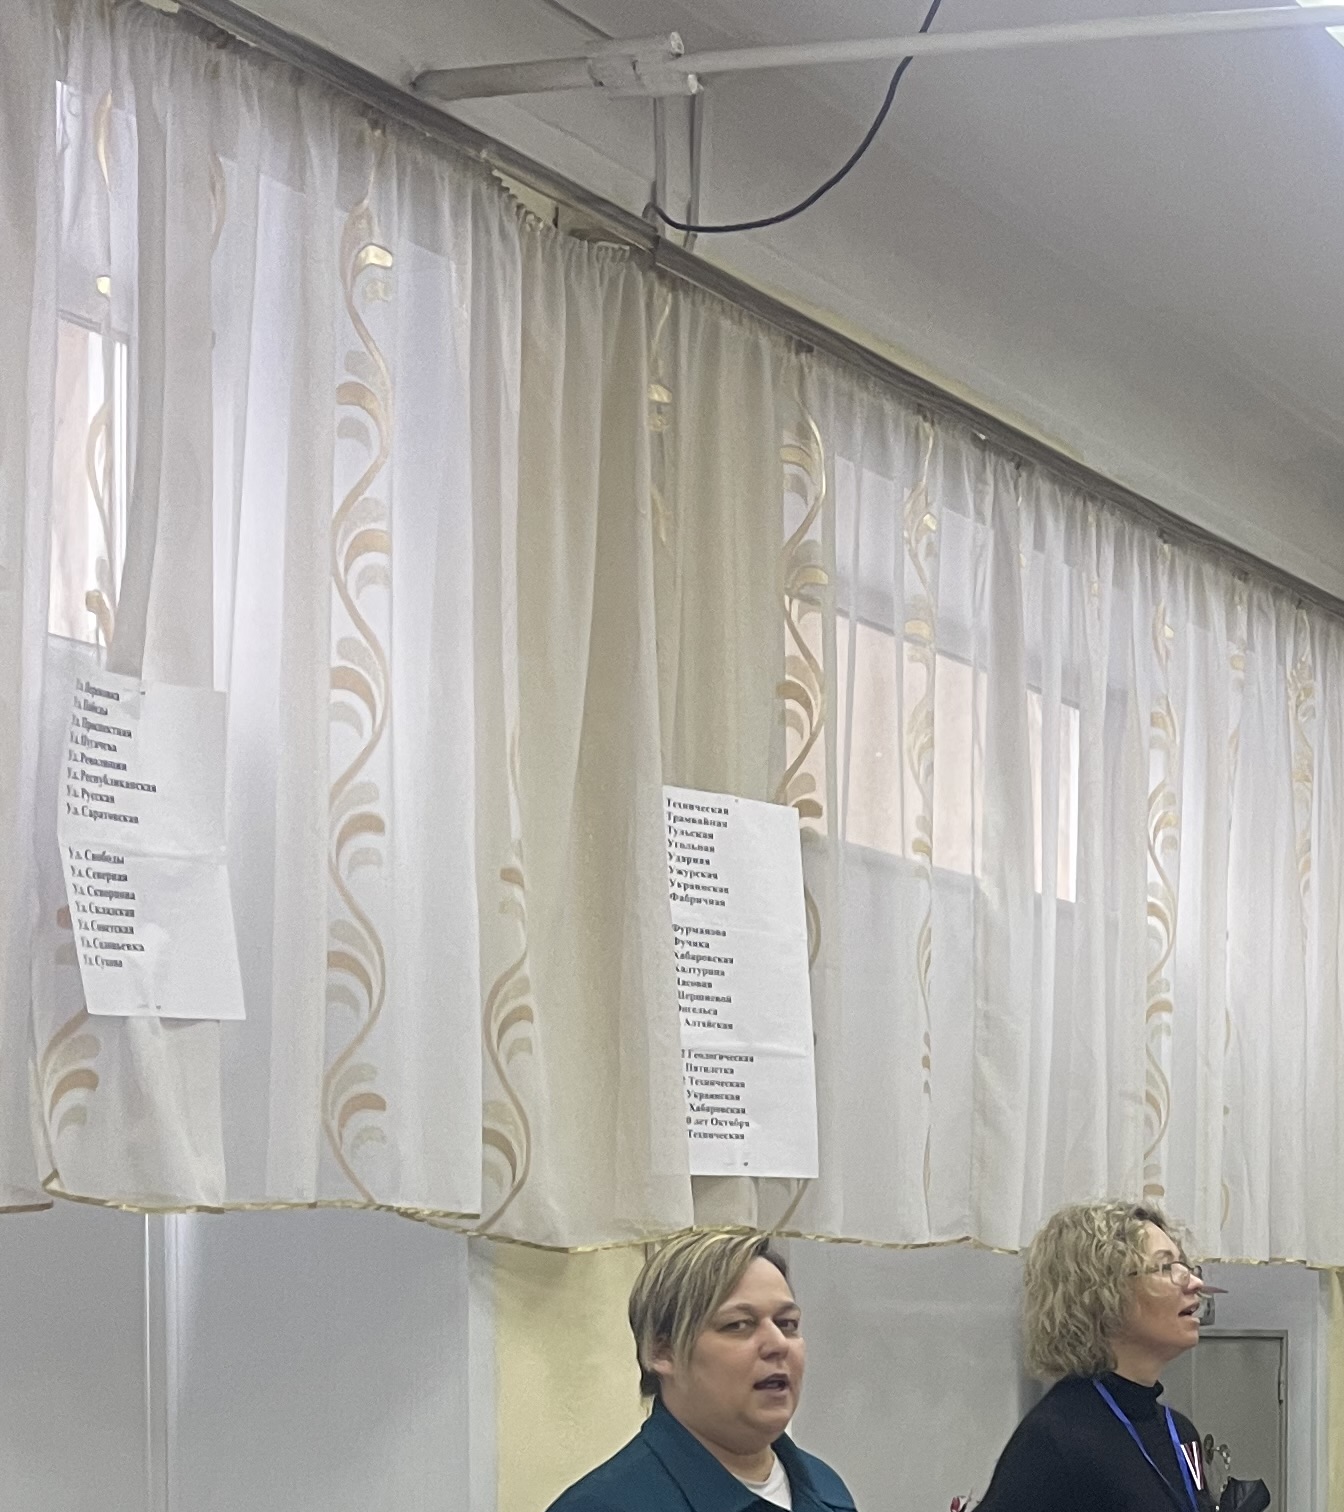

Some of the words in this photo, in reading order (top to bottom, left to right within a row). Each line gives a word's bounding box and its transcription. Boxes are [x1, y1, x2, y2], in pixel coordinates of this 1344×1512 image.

[667, 811, 728, 828] Трамвайная
[667, 825, 714, 840] Тульская
[668, 838, 715, 853] Угольная
[669, 878, 729, 894] Украинская
[669, 892, 726, 906] Фабричная
